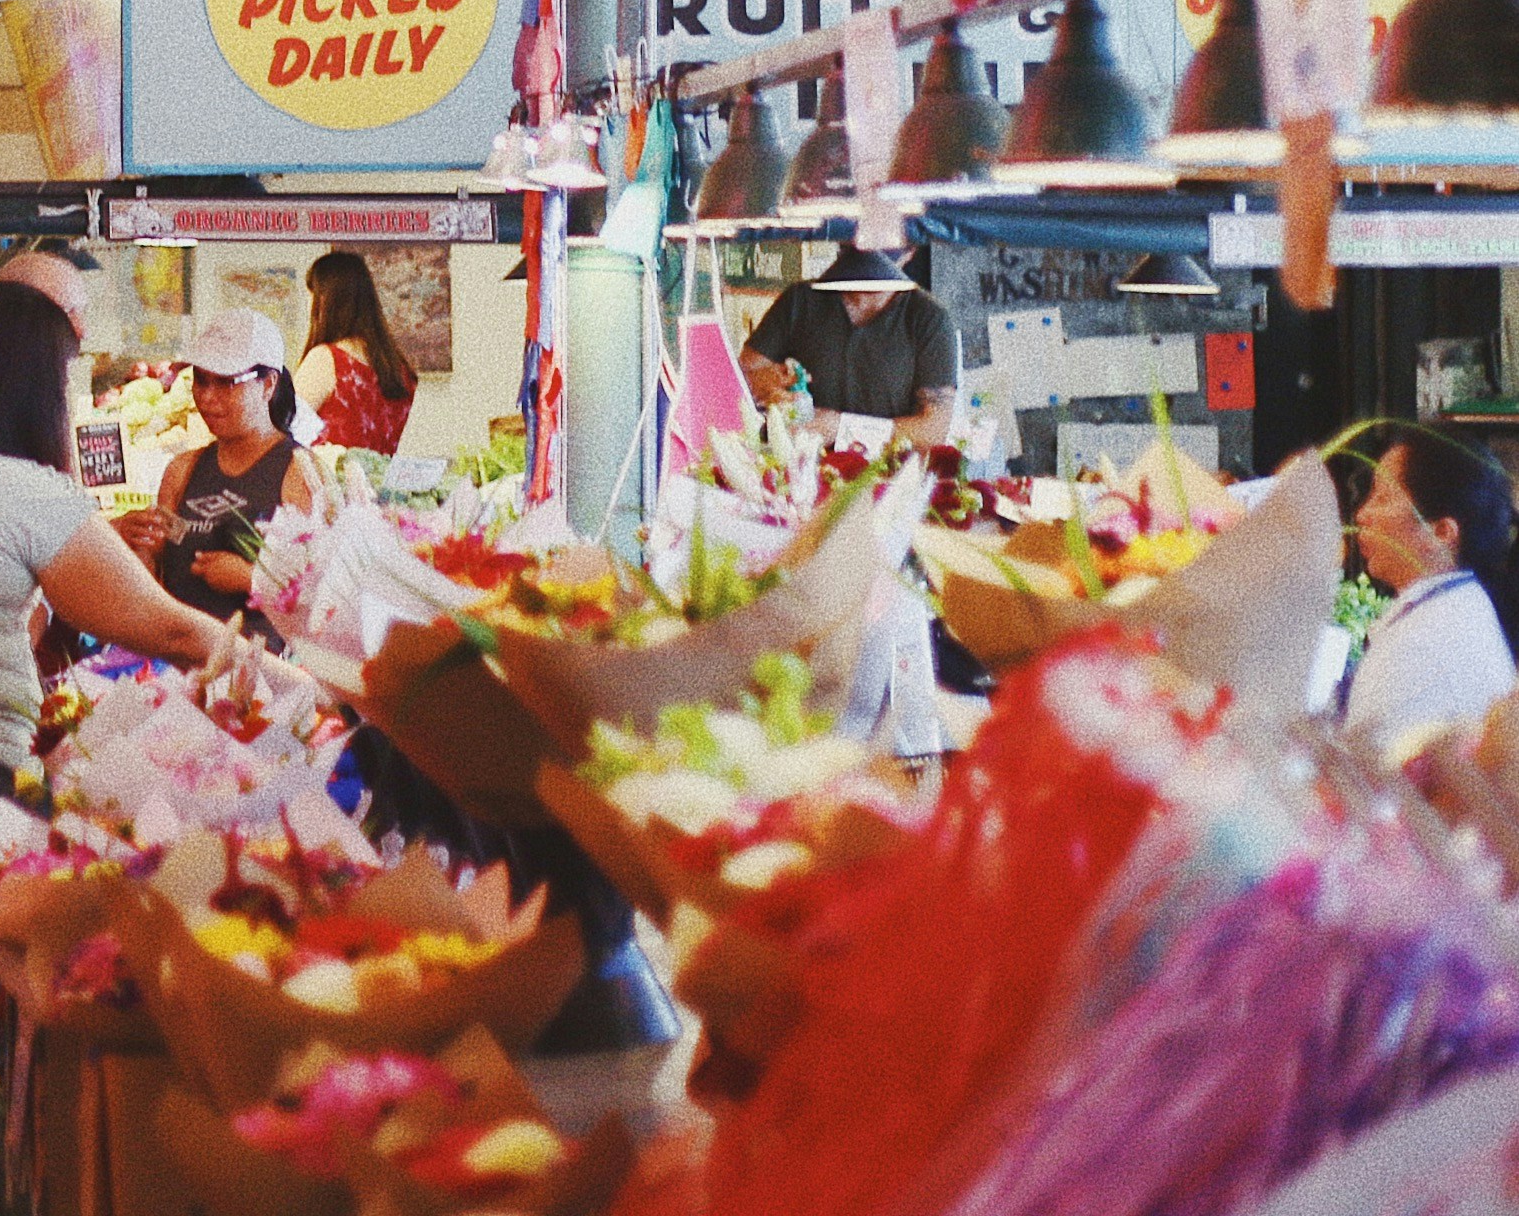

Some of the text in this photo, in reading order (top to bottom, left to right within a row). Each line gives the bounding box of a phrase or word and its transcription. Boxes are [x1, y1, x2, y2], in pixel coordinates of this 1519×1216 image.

[267, 26, 446, 88] DAILY
[175, 209, 431, 233] ORGANIC BERRIES
